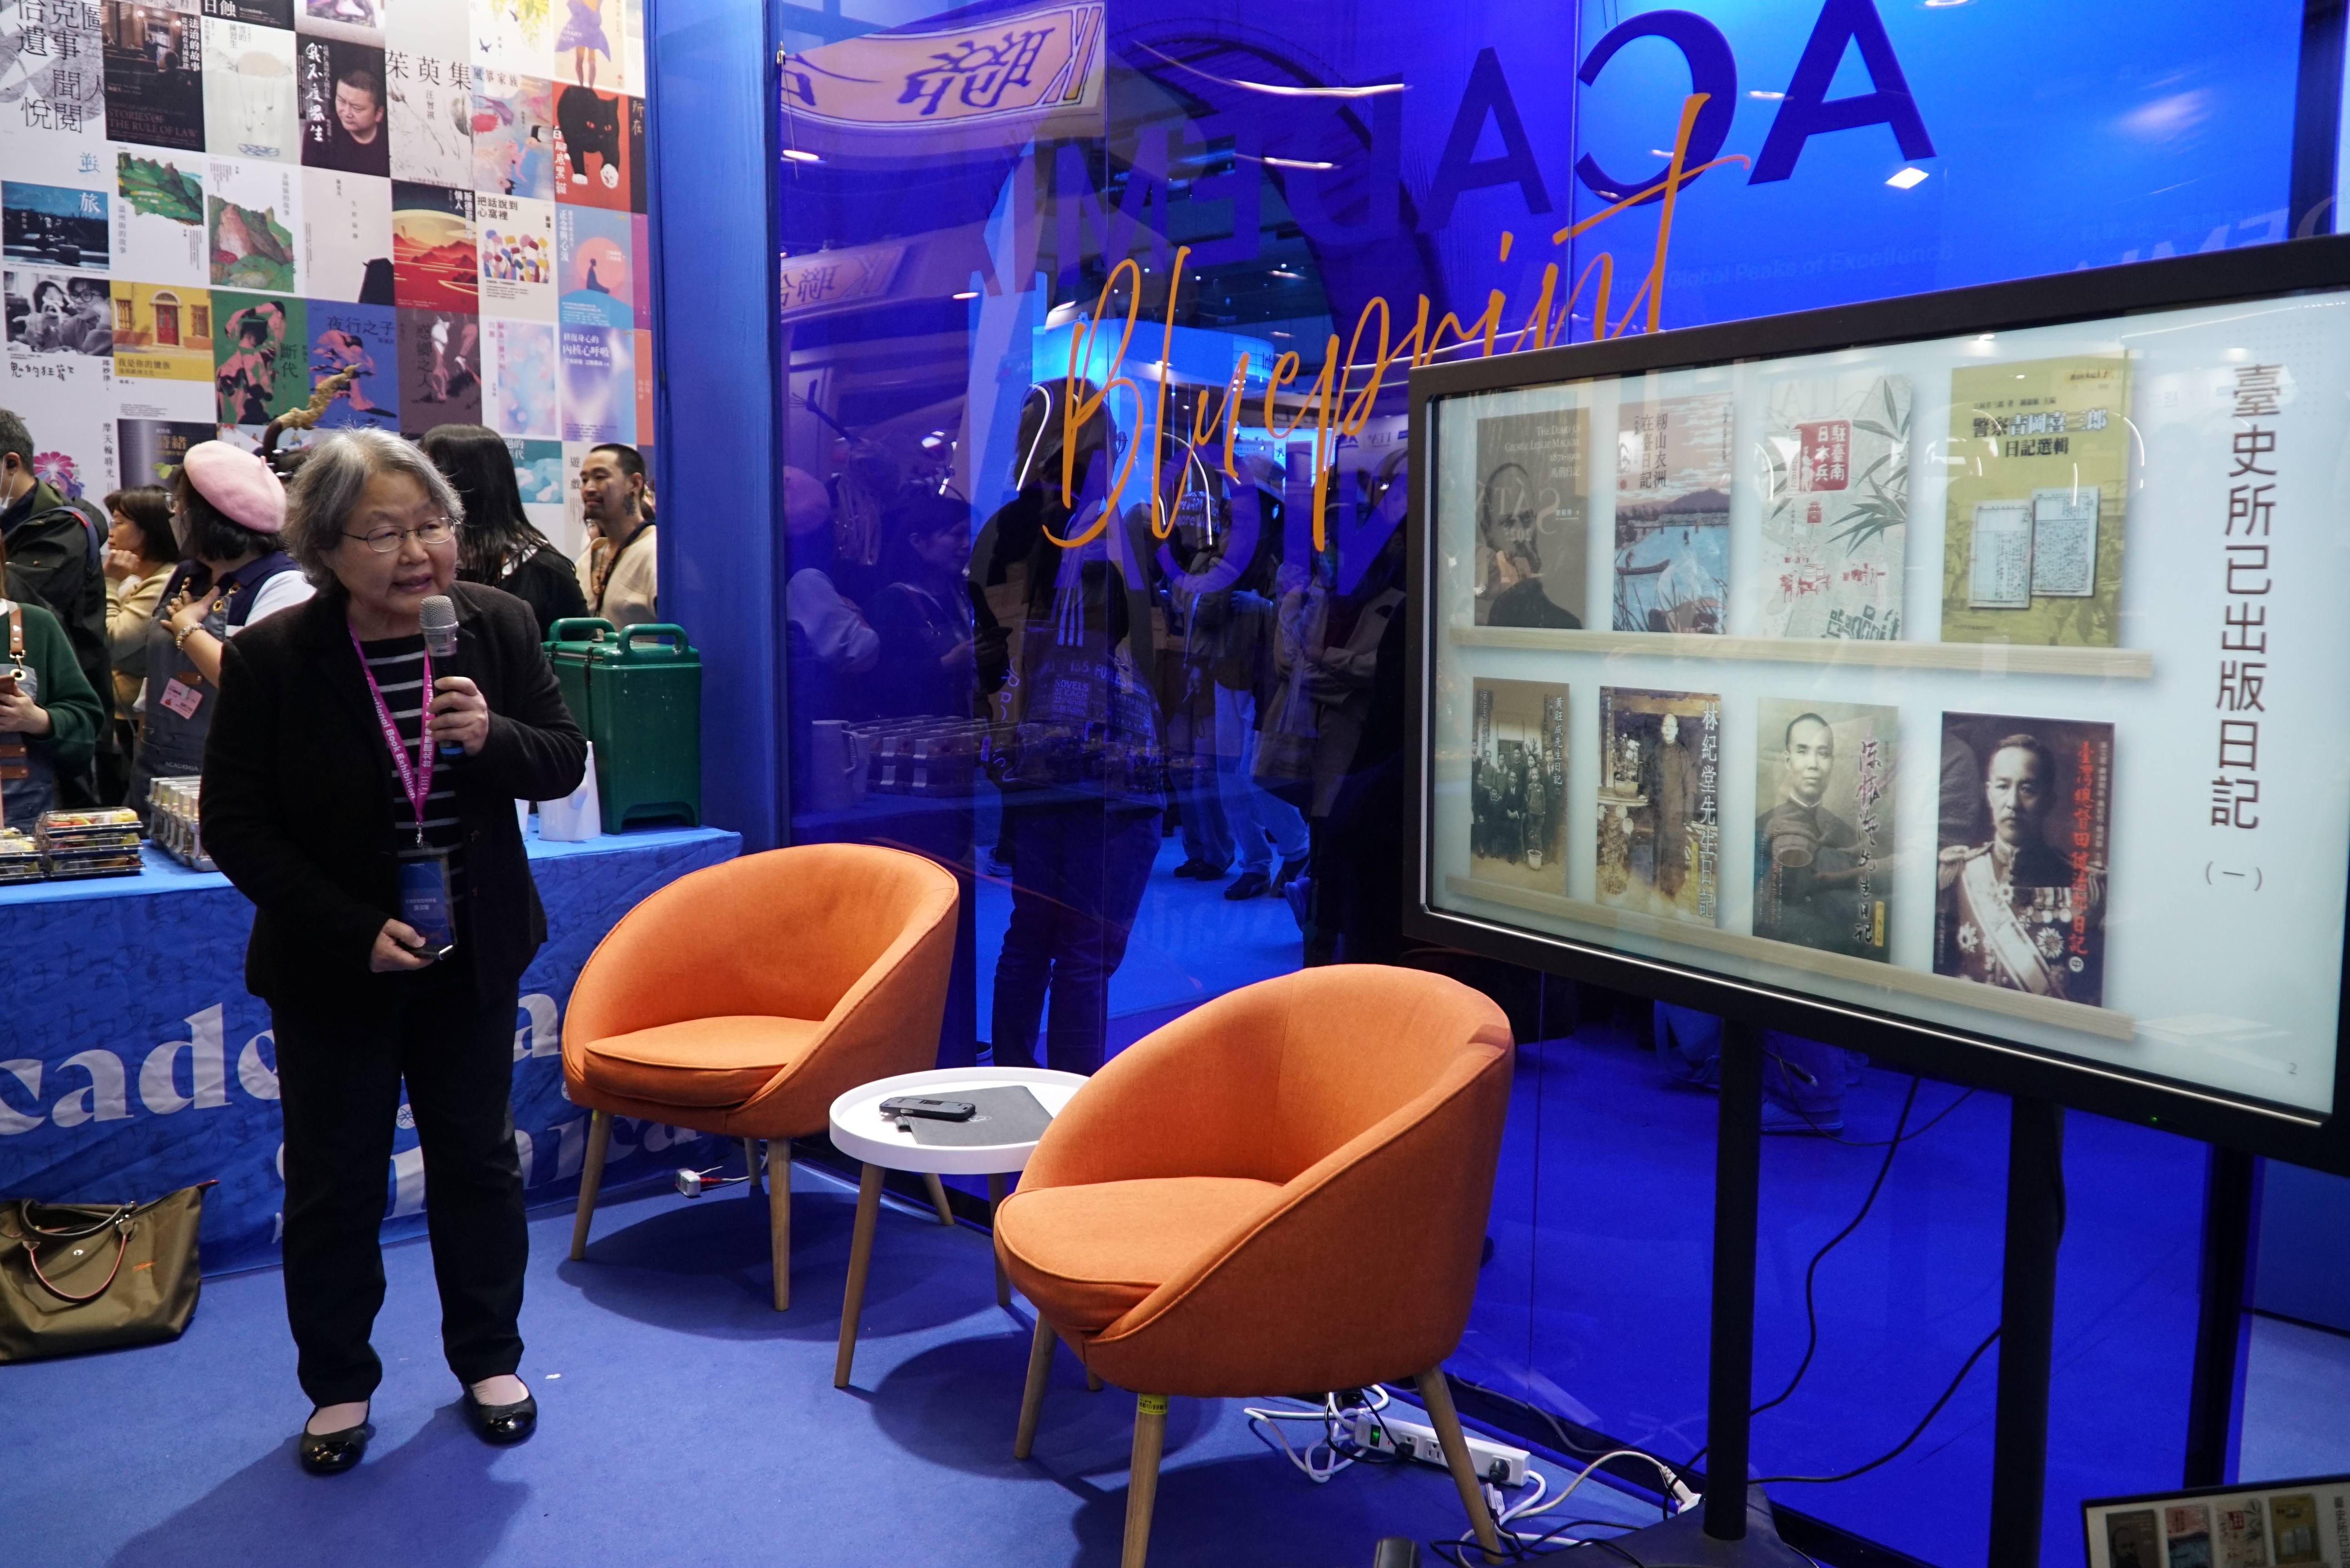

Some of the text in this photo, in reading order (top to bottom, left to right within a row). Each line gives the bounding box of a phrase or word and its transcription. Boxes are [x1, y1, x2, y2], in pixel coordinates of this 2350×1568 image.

[189, 17, 201, 71] 法治的故事
[385, 48, 472, 91] 茱萸集
[553, 125, 567, 195] 白腳底黑貓
[477, 196, 518, 211] 把話說到
[477, 207, 508, 221] 心窩裡
[326, 315, 395, 336] 夜行之子
[280, 343, 298, 378] 斷代
[1973, 407, 2108, 438] 警察吉岡喜三郎
[102, 422, 115, 478] 摩天輪時光
[1639, 413, 1654, 489] 在臺日記
[1814, 425, 1830, 482] 日本兵
[1830, 424, 1847, 481] 駐臺南
[2005, 436, 2069, 458] 日記選輯
[569, 456, 581, 490] 遊戲
[1551, 466, 1581, 478] 馬偕日記
[2209, 363, 2285, 830] 臺史所已出版日記
[385, 729, 401, 752] Book
[395, 753, 417, 799] Exhibition
[1699, 702, 1719, 918] 林紀堂先生日記
[2288, 1061, 2298, 1075] 2
